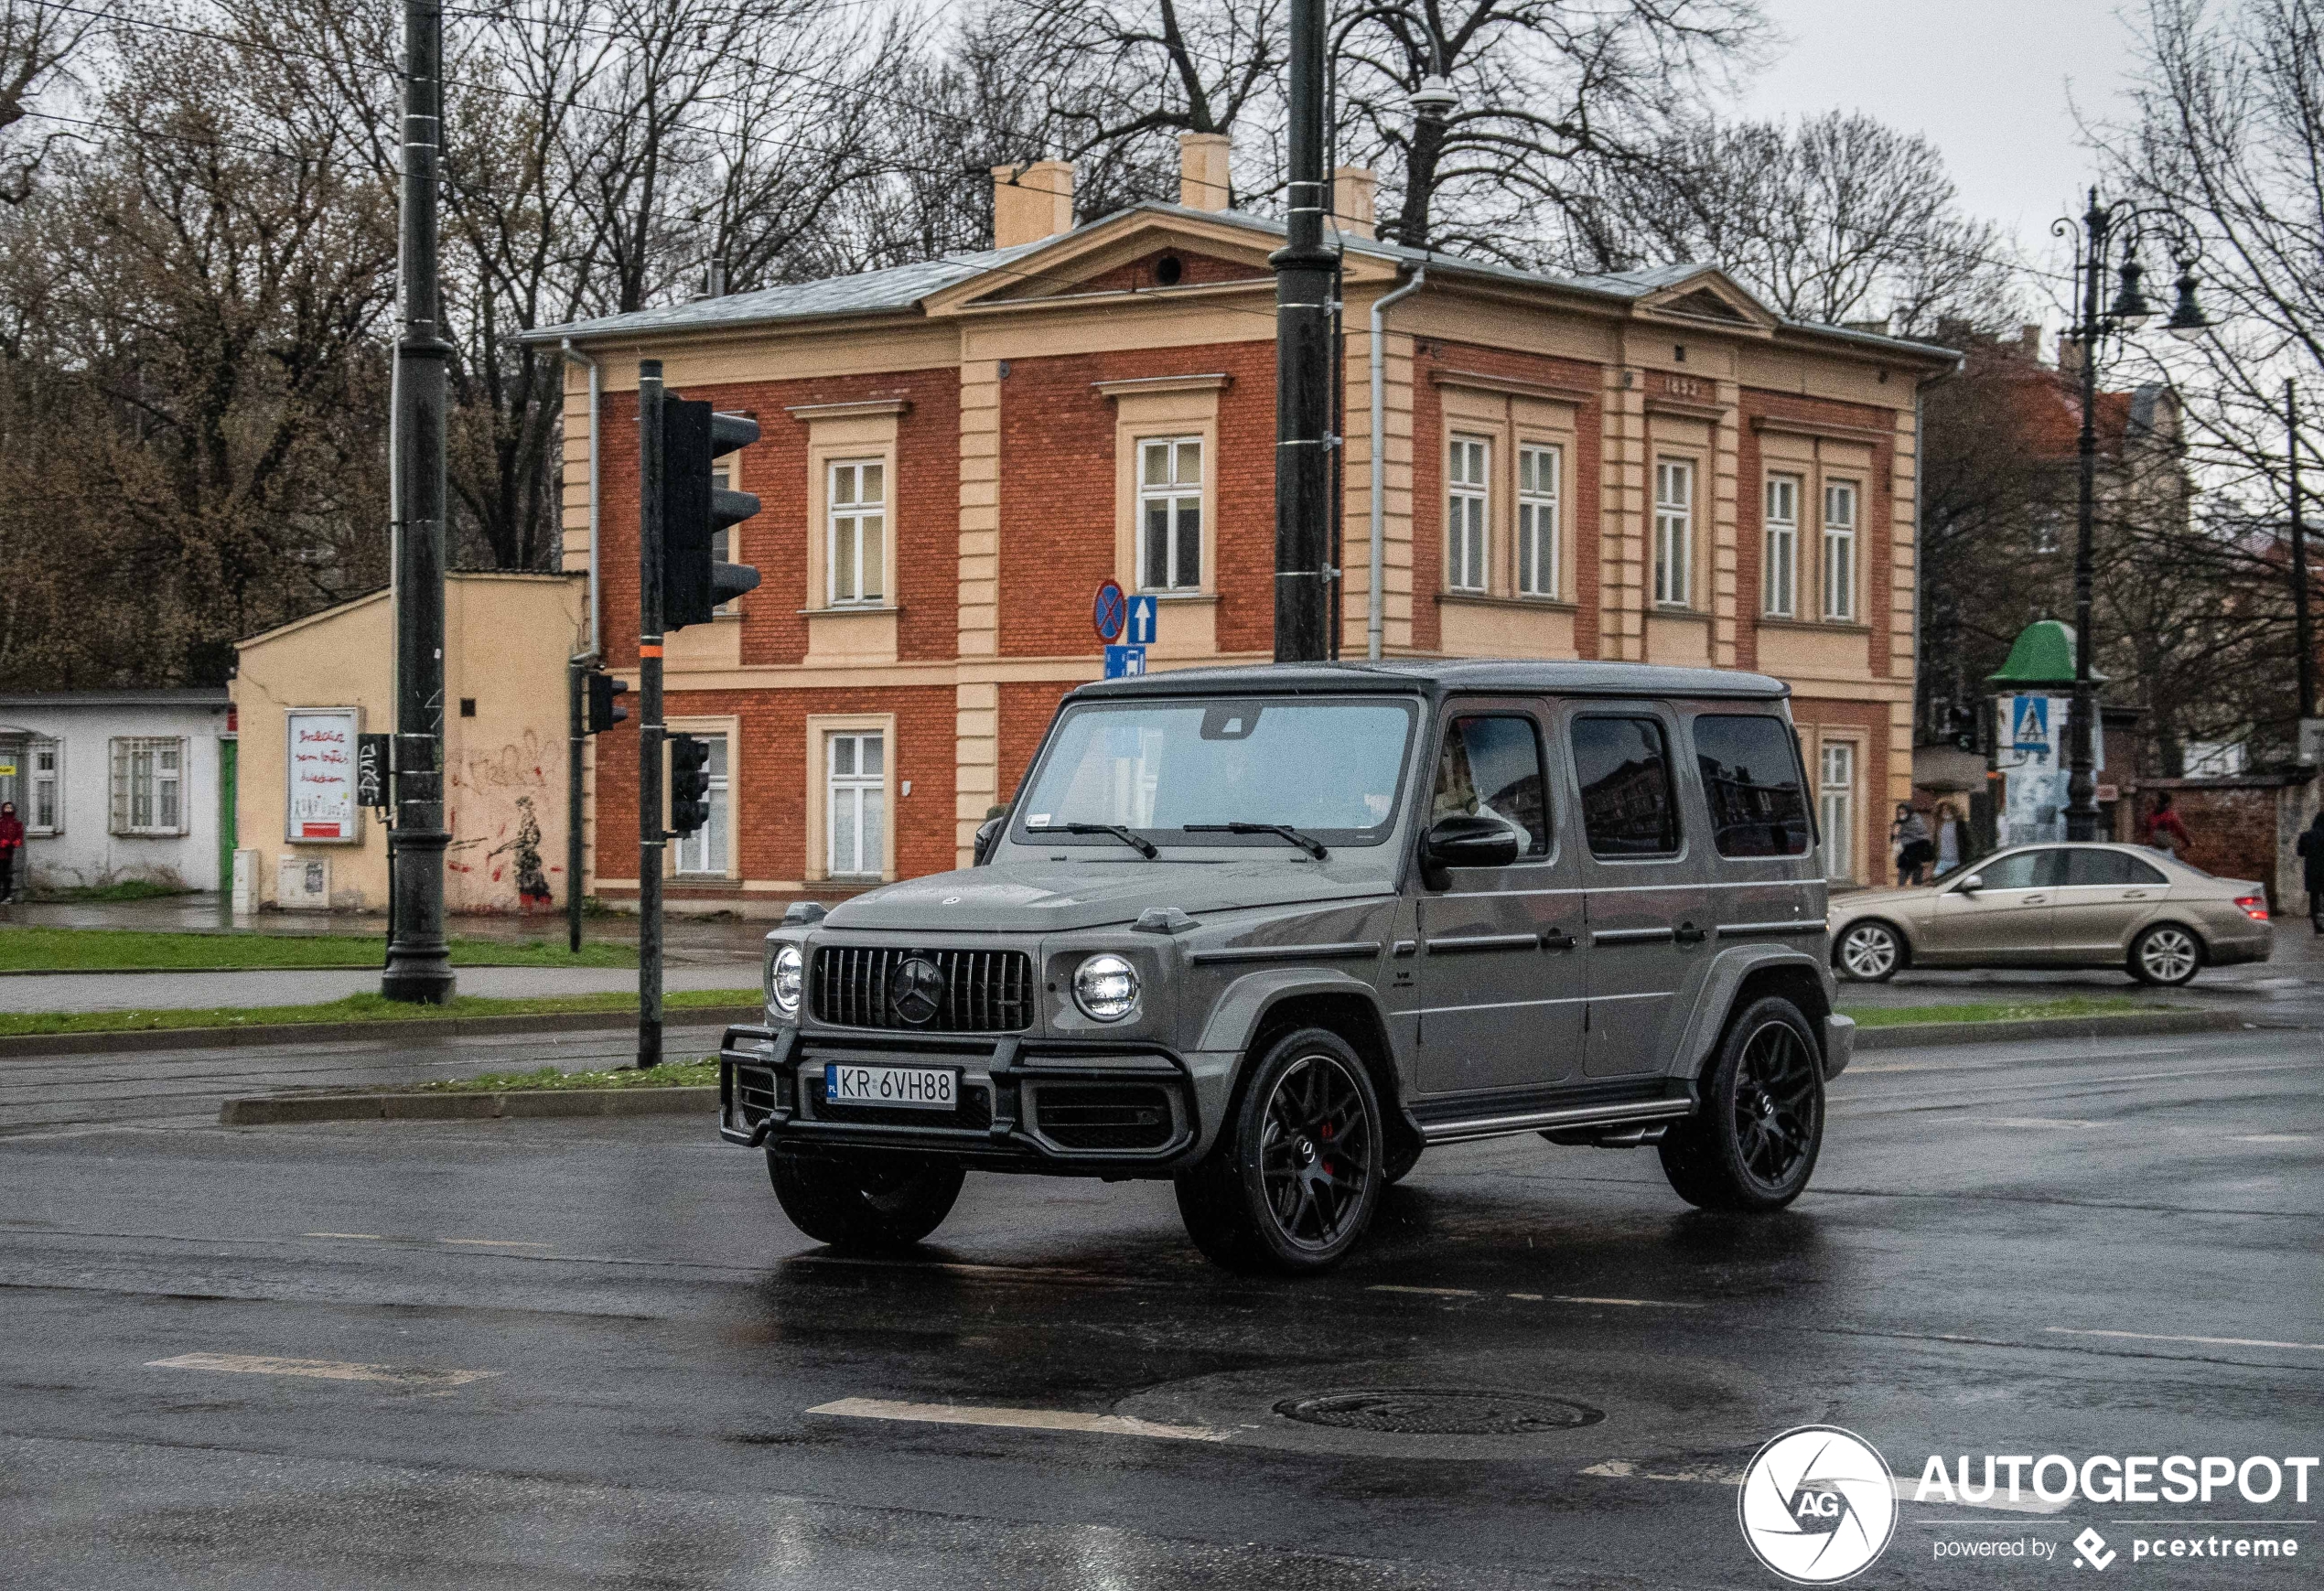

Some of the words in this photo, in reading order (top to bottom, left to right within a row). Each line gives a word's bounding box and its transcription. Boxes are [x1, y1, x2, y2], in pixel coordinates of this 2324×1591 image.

[828, 1085, 837, 1093] PL
[842, 1069, 871, 1098] KR
[880, 1070, 951, 1101] 6VH88
